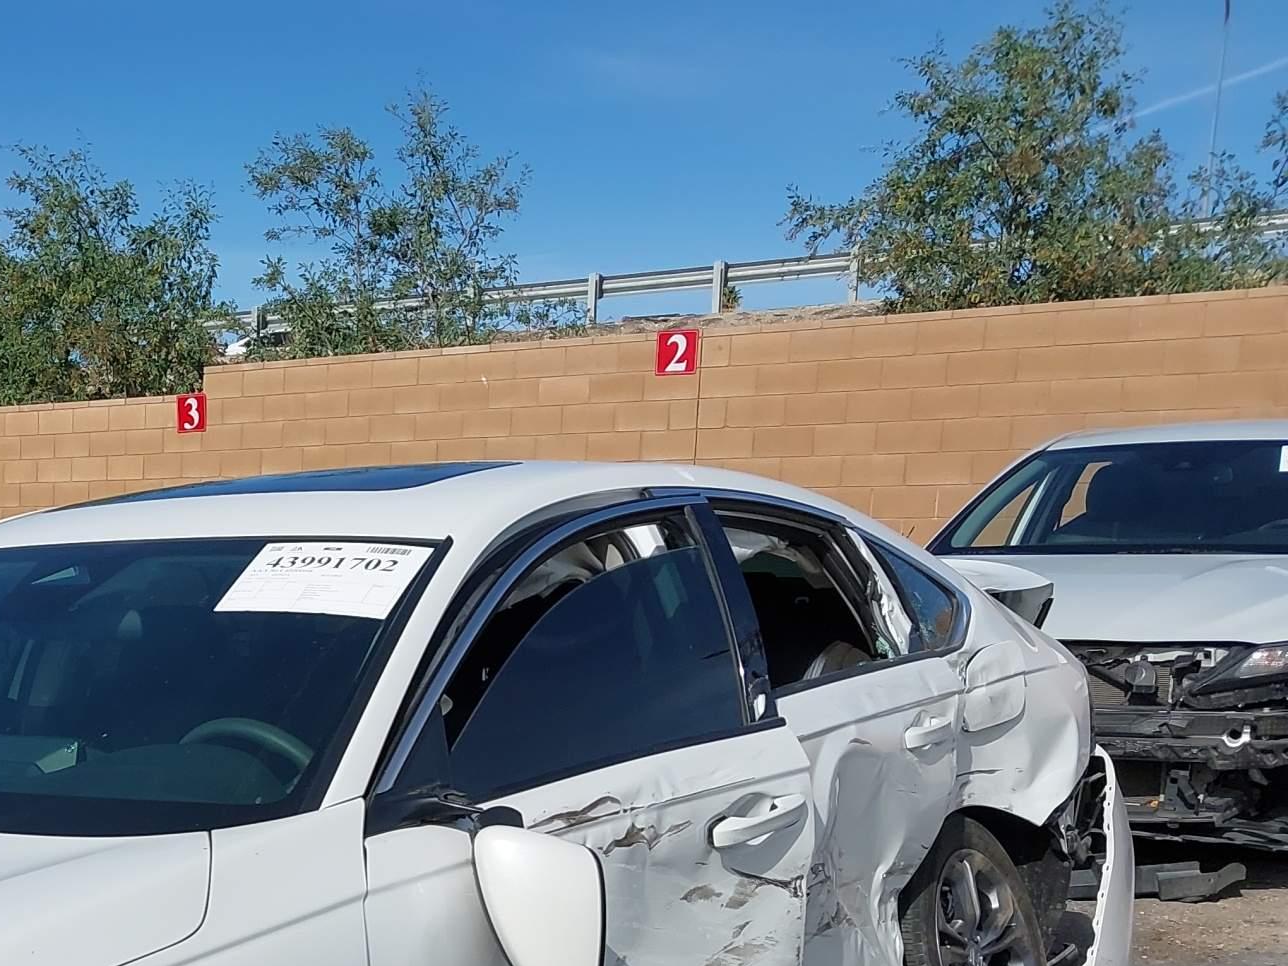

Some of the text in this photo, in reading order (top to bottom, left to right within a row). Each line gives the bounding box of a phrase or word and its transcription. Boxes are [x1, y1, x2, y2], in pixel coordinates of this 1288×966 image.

[664, 333, 688, 372] 2
[183, 397, 200, 430] 3
[265, 555, 399, 573] 43991702
